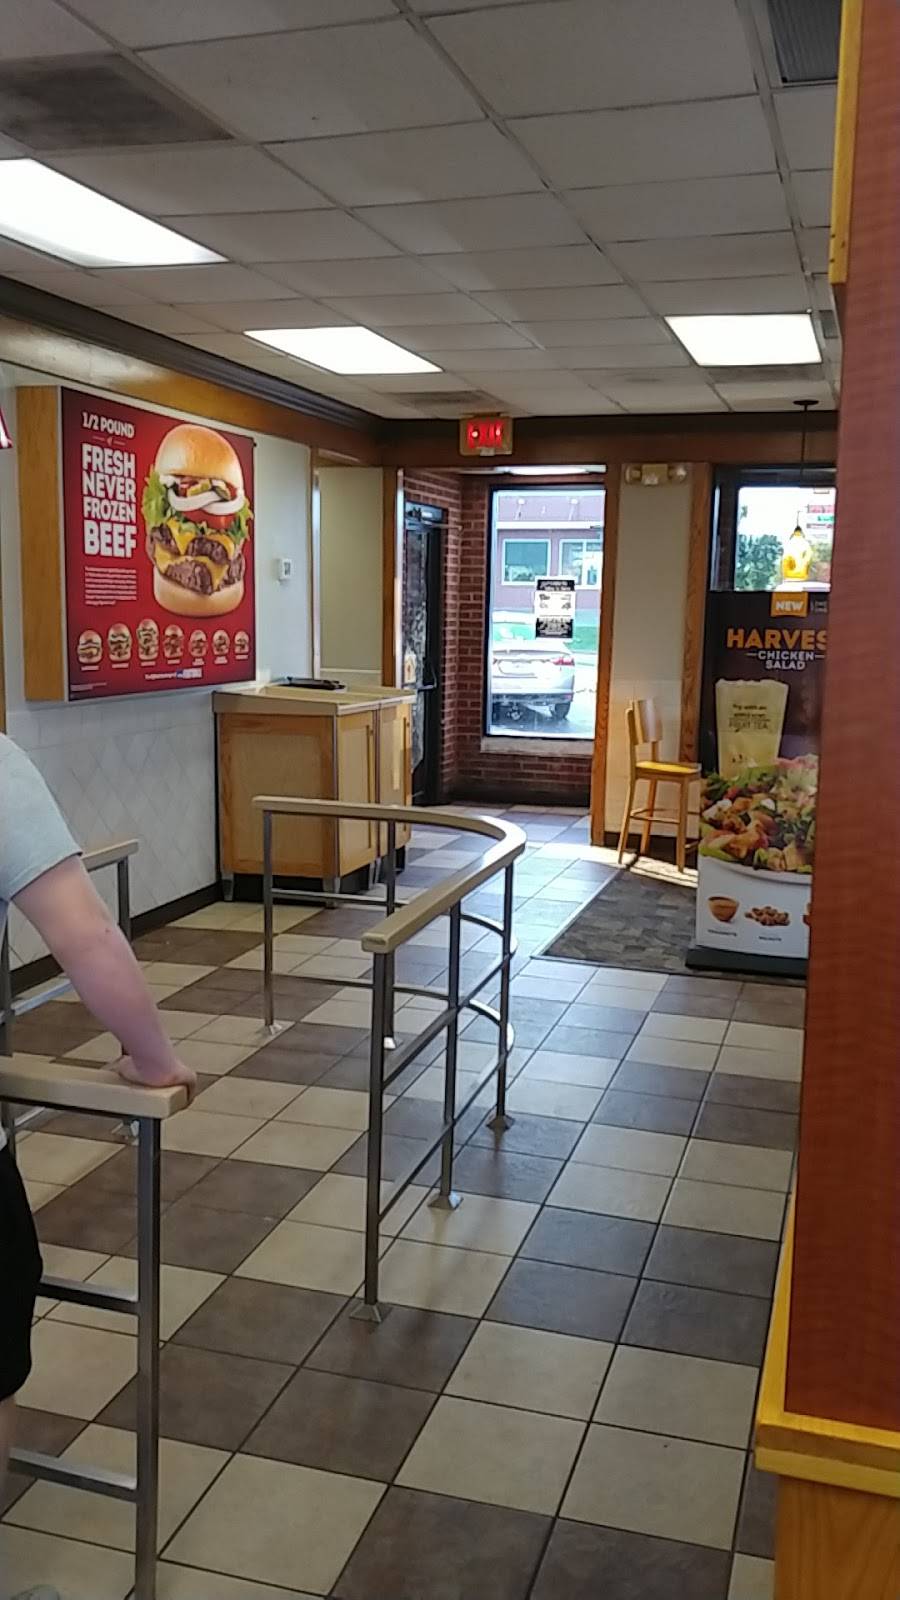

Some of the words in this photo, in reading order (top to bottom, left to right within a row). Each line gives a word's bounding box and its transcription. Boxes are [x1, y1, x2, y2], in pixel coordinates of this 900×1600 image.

[82, 412, 98, 430] 1/2
[101, 417, 135, 438] POUND
[82, 443, 135, 478] FRESH
[82, 470, 136, 502] NEVER
[83, 496, 136, 523] FROZEN
[83, 519, 137, 558] BEEF
[775, 601, 803, 611] NEW
[758, 650, 814, 660] CHICKEN
[765, 660, 806, 670] SALAD
